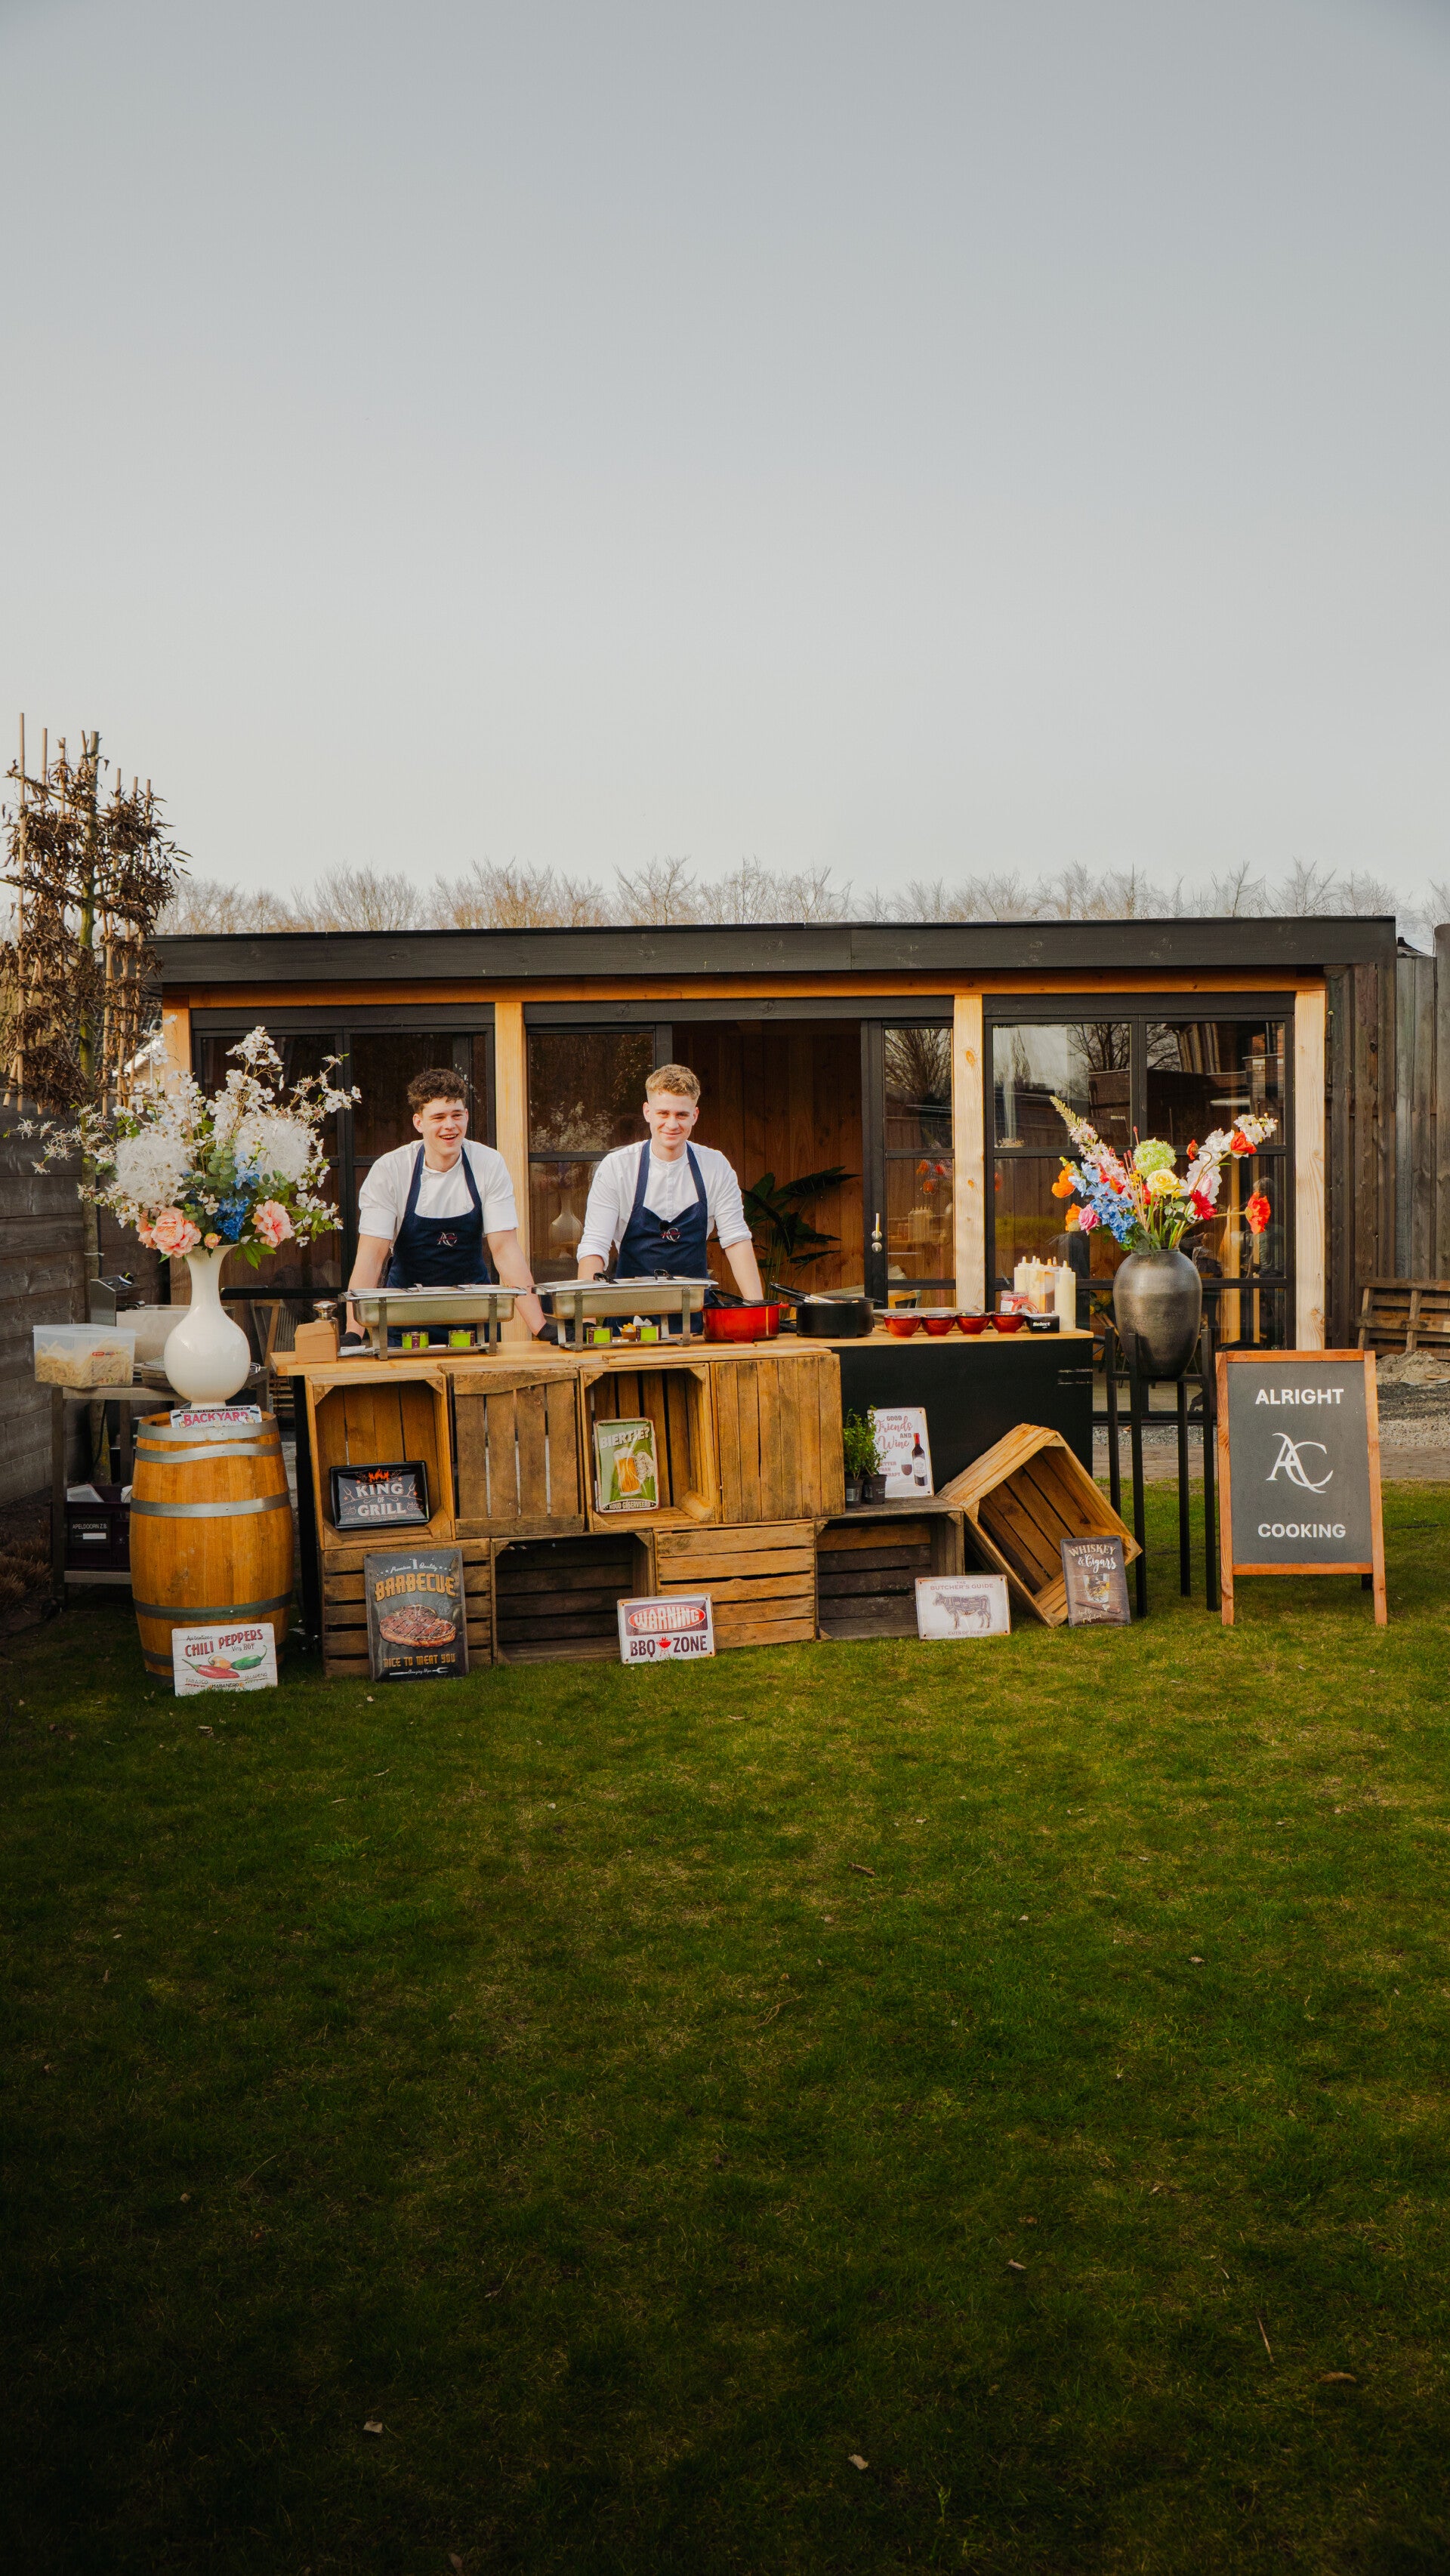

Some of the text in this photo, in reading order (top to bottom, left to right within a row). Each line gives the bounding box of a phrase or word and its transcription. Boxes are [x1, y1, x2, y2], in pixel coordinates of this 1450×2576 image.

[1254, 1388, 1344, 1405] ALRIGHT
[184, 1411, 248, 1427] BACKYARD
[875, 1415, 913, 1434] Friends
[878, 1435, 910, 1450] Wine
[1266, 1432, 1334, 1494] AC
[355, 1483, 404, 1498] KING
[357, 1502, 407, 1518] GRILL
[1257, 1523, 1347, 1539] COOKING
[1068, 1544, 1117, 1557] WHISKEY
[390, 1564, 412, 1574] Premium
[419, 1562, 438, 1572] Quality
[1078, 1554, 1118, 1574] & Cigars
[375, 1573, 457, 1602] BARBECUE
[634, 1605, 700, 1630] WARNING
[184, 1628, 264, 1657] CHILI PEPPERS
[630, 1635, 708, 1658] BBQ ZONE
[383, 1653, 456, 1668] NICE TO MEAT YOU
